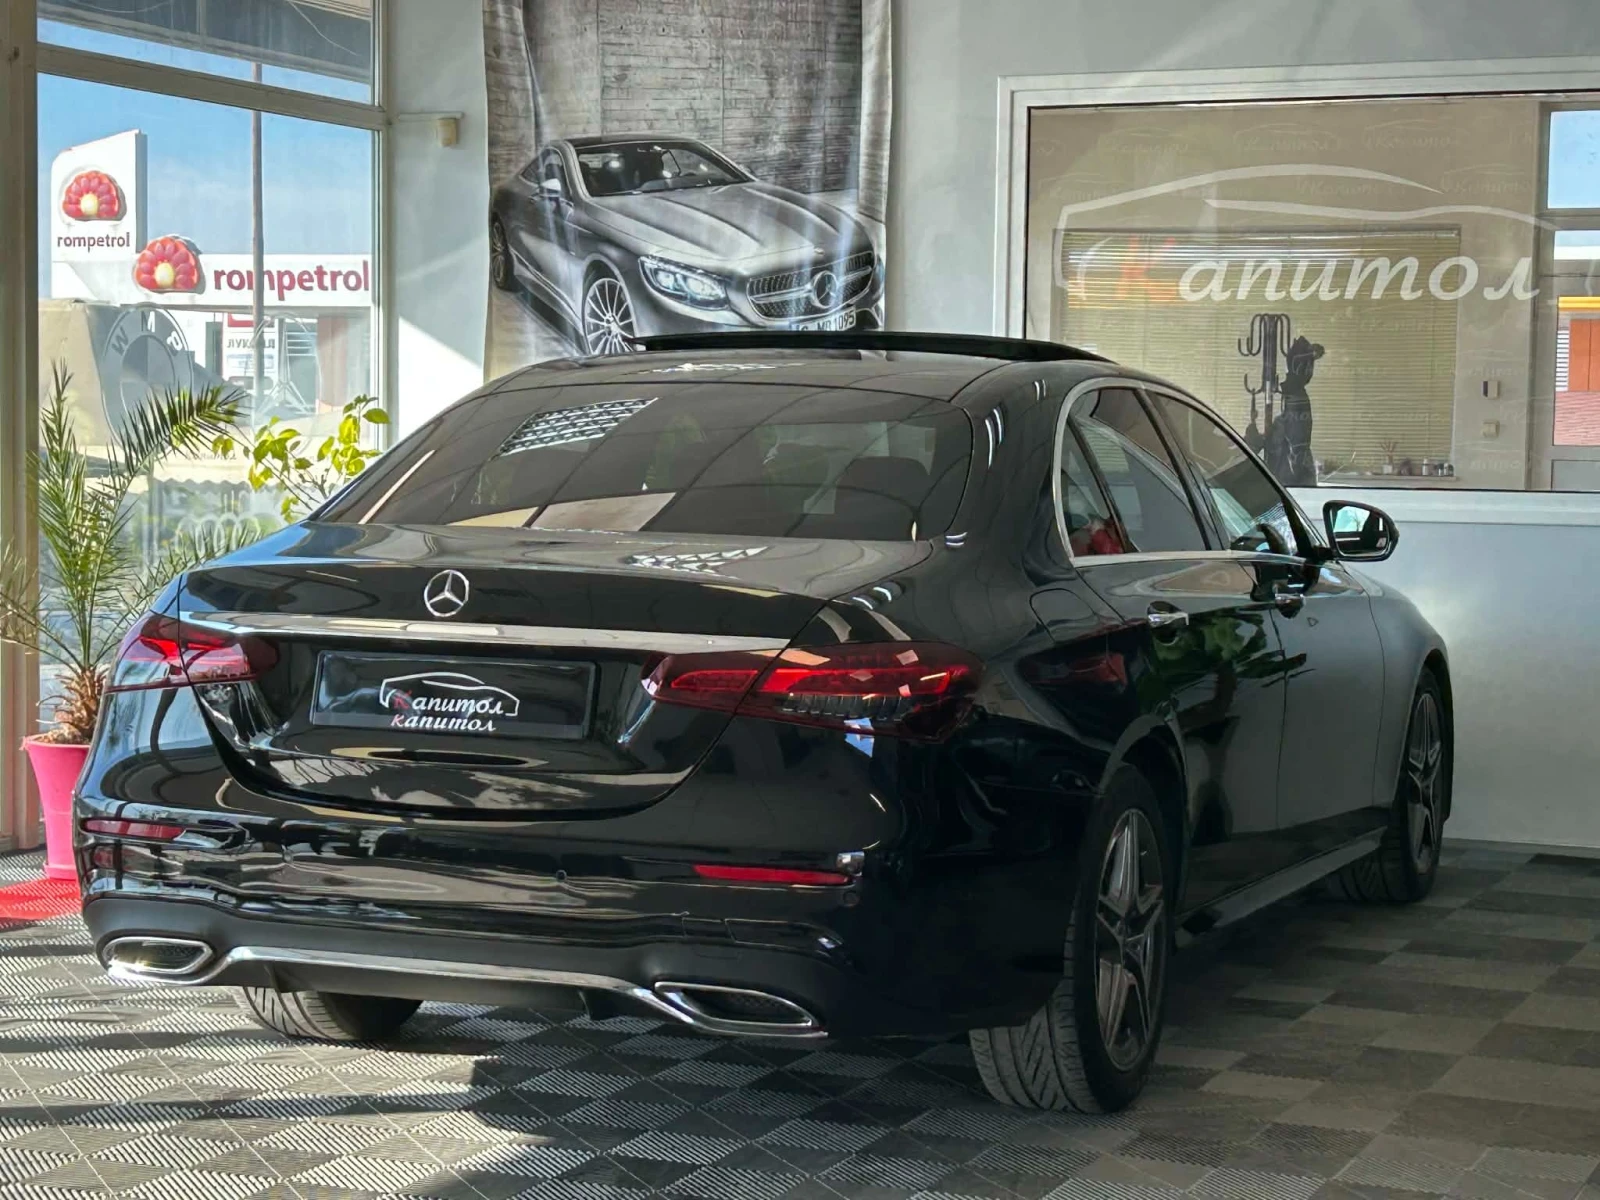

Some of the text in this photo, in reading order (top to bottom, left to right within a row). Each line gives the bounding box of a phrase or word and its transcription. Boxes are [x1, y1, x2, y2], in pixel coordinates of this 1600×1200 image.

[57, 231, 130, 253] rompetrol
[213, 260, 369, 301] rompetrol
[1115, 235, 1540, 302] Капитол
[393, 690, 504, 714] Капитол
